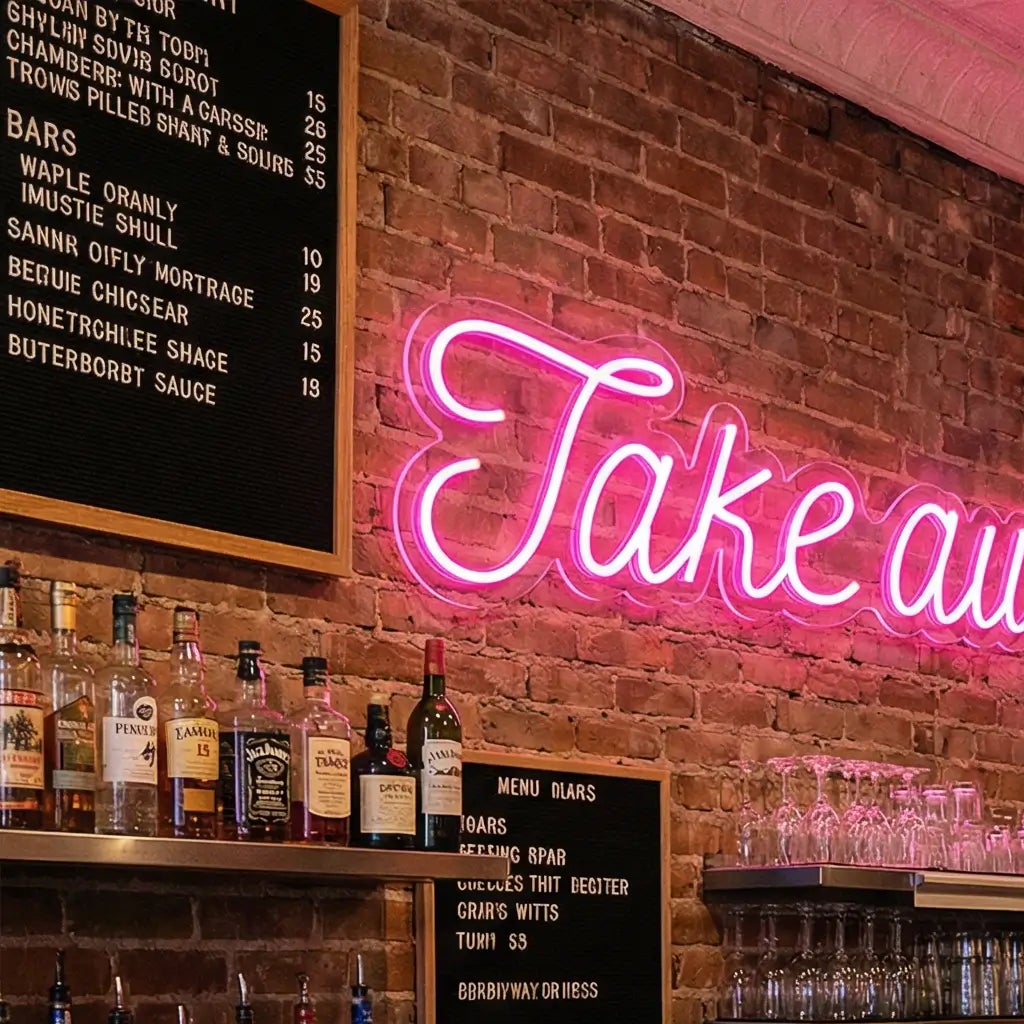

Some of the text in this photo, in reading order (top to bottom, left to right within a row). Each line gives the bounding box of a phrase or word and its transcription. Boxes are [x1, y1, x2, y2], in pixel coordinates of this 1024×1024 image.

[128, 73, 175, 110] WITH
[181, 94, 195, 116] A
[6, 107, 78, 157] BARS
[303, 115, 327, 140] 26
[303, 141, 327, 165] 25
[20, 153, 179, 223] WAPLE ORANLY
[115, 213, 179, 250] SHULL
[7, 216, 256, 310] SANNR OIFLY MORTRAGE
[302, 246, 323, 269] 10
[303, 272, 322, 294] 19
[91, 280, 190, 326] CHICSEAR
[300, 306, 323, 330] 25
[302, 341, 322, 364] 15
[154, 371, 217, 406] SAUCE
[418, 316, 862, 608] Take
[497, 776, 541, 798] MENU
[529, 874, 562, 894] THIT
[515, 902, 560, 923] WITTS
